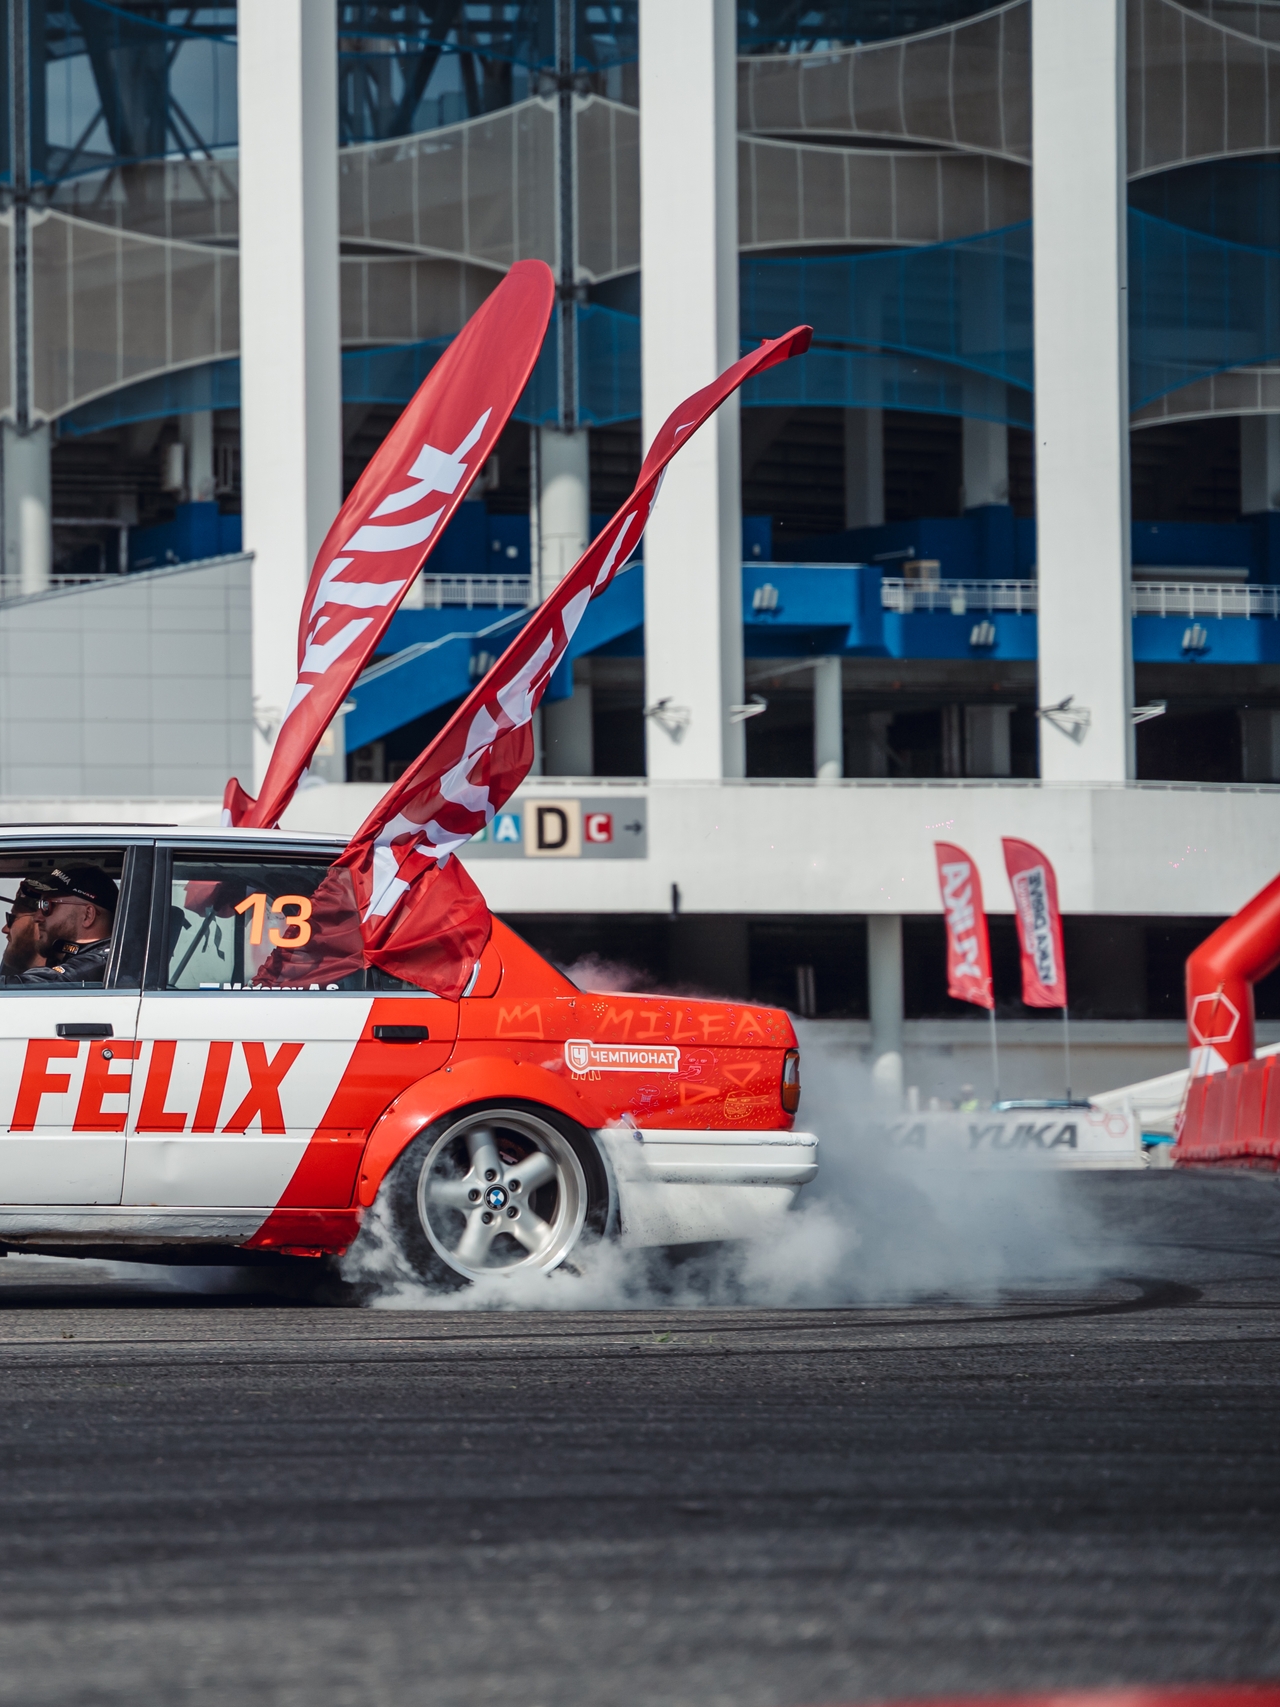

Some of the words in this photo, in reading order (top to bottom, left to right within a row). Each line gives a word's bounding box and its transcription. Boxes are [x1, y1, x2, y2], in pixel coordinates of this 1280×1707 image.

[495, 814, 520, 842] A
[536, 806, 569, 849] D
[588, 814, 609, 842] C
[234, 892, 313, 948] 13
[591, 1050, 675, 1064] ЧЕМПИОНАТ
[10, 1038, 305, 1134] FELIX
[968, 1122, 1078, 1149] YUKA
